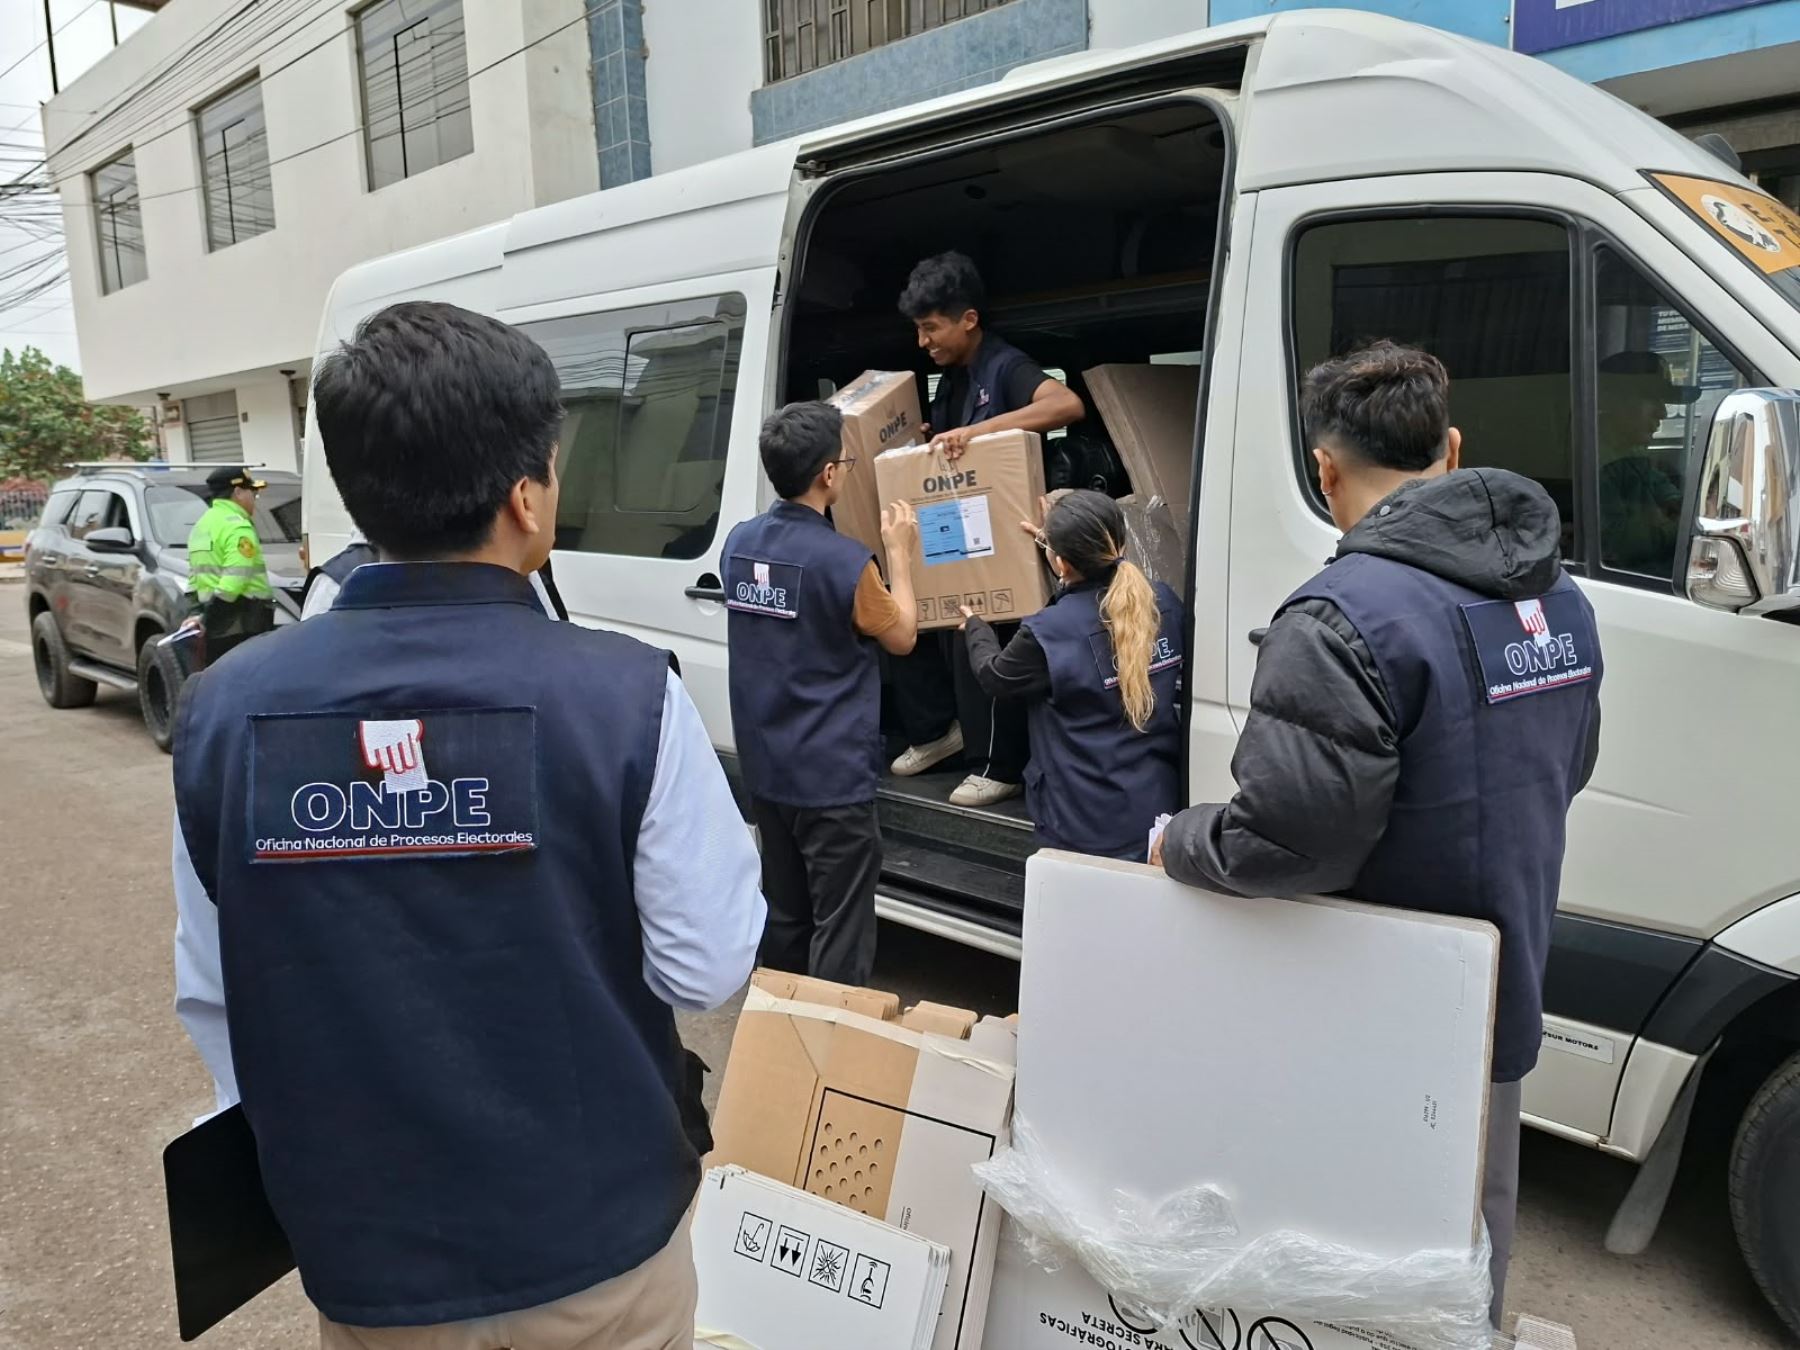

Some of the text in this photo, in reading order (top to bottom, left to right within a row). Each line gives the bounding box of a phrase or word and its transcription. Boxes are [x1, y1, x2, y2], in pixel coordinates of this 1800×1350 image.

[879, 411, 907, 443] ONPE
[923, 469, 977, 493] ONPE
[737, 582, 786, 608] ONPE
[1504, 633, 1577, 676] ONPE
[1489, 683, 1512, 695] Oficina
[291, 777, 491, 832] ONPE
[255, 830, 533, 851] Oficina Nacional de Procesos Electorales
[1081, 1311, 1141, 1345] SECRETA
